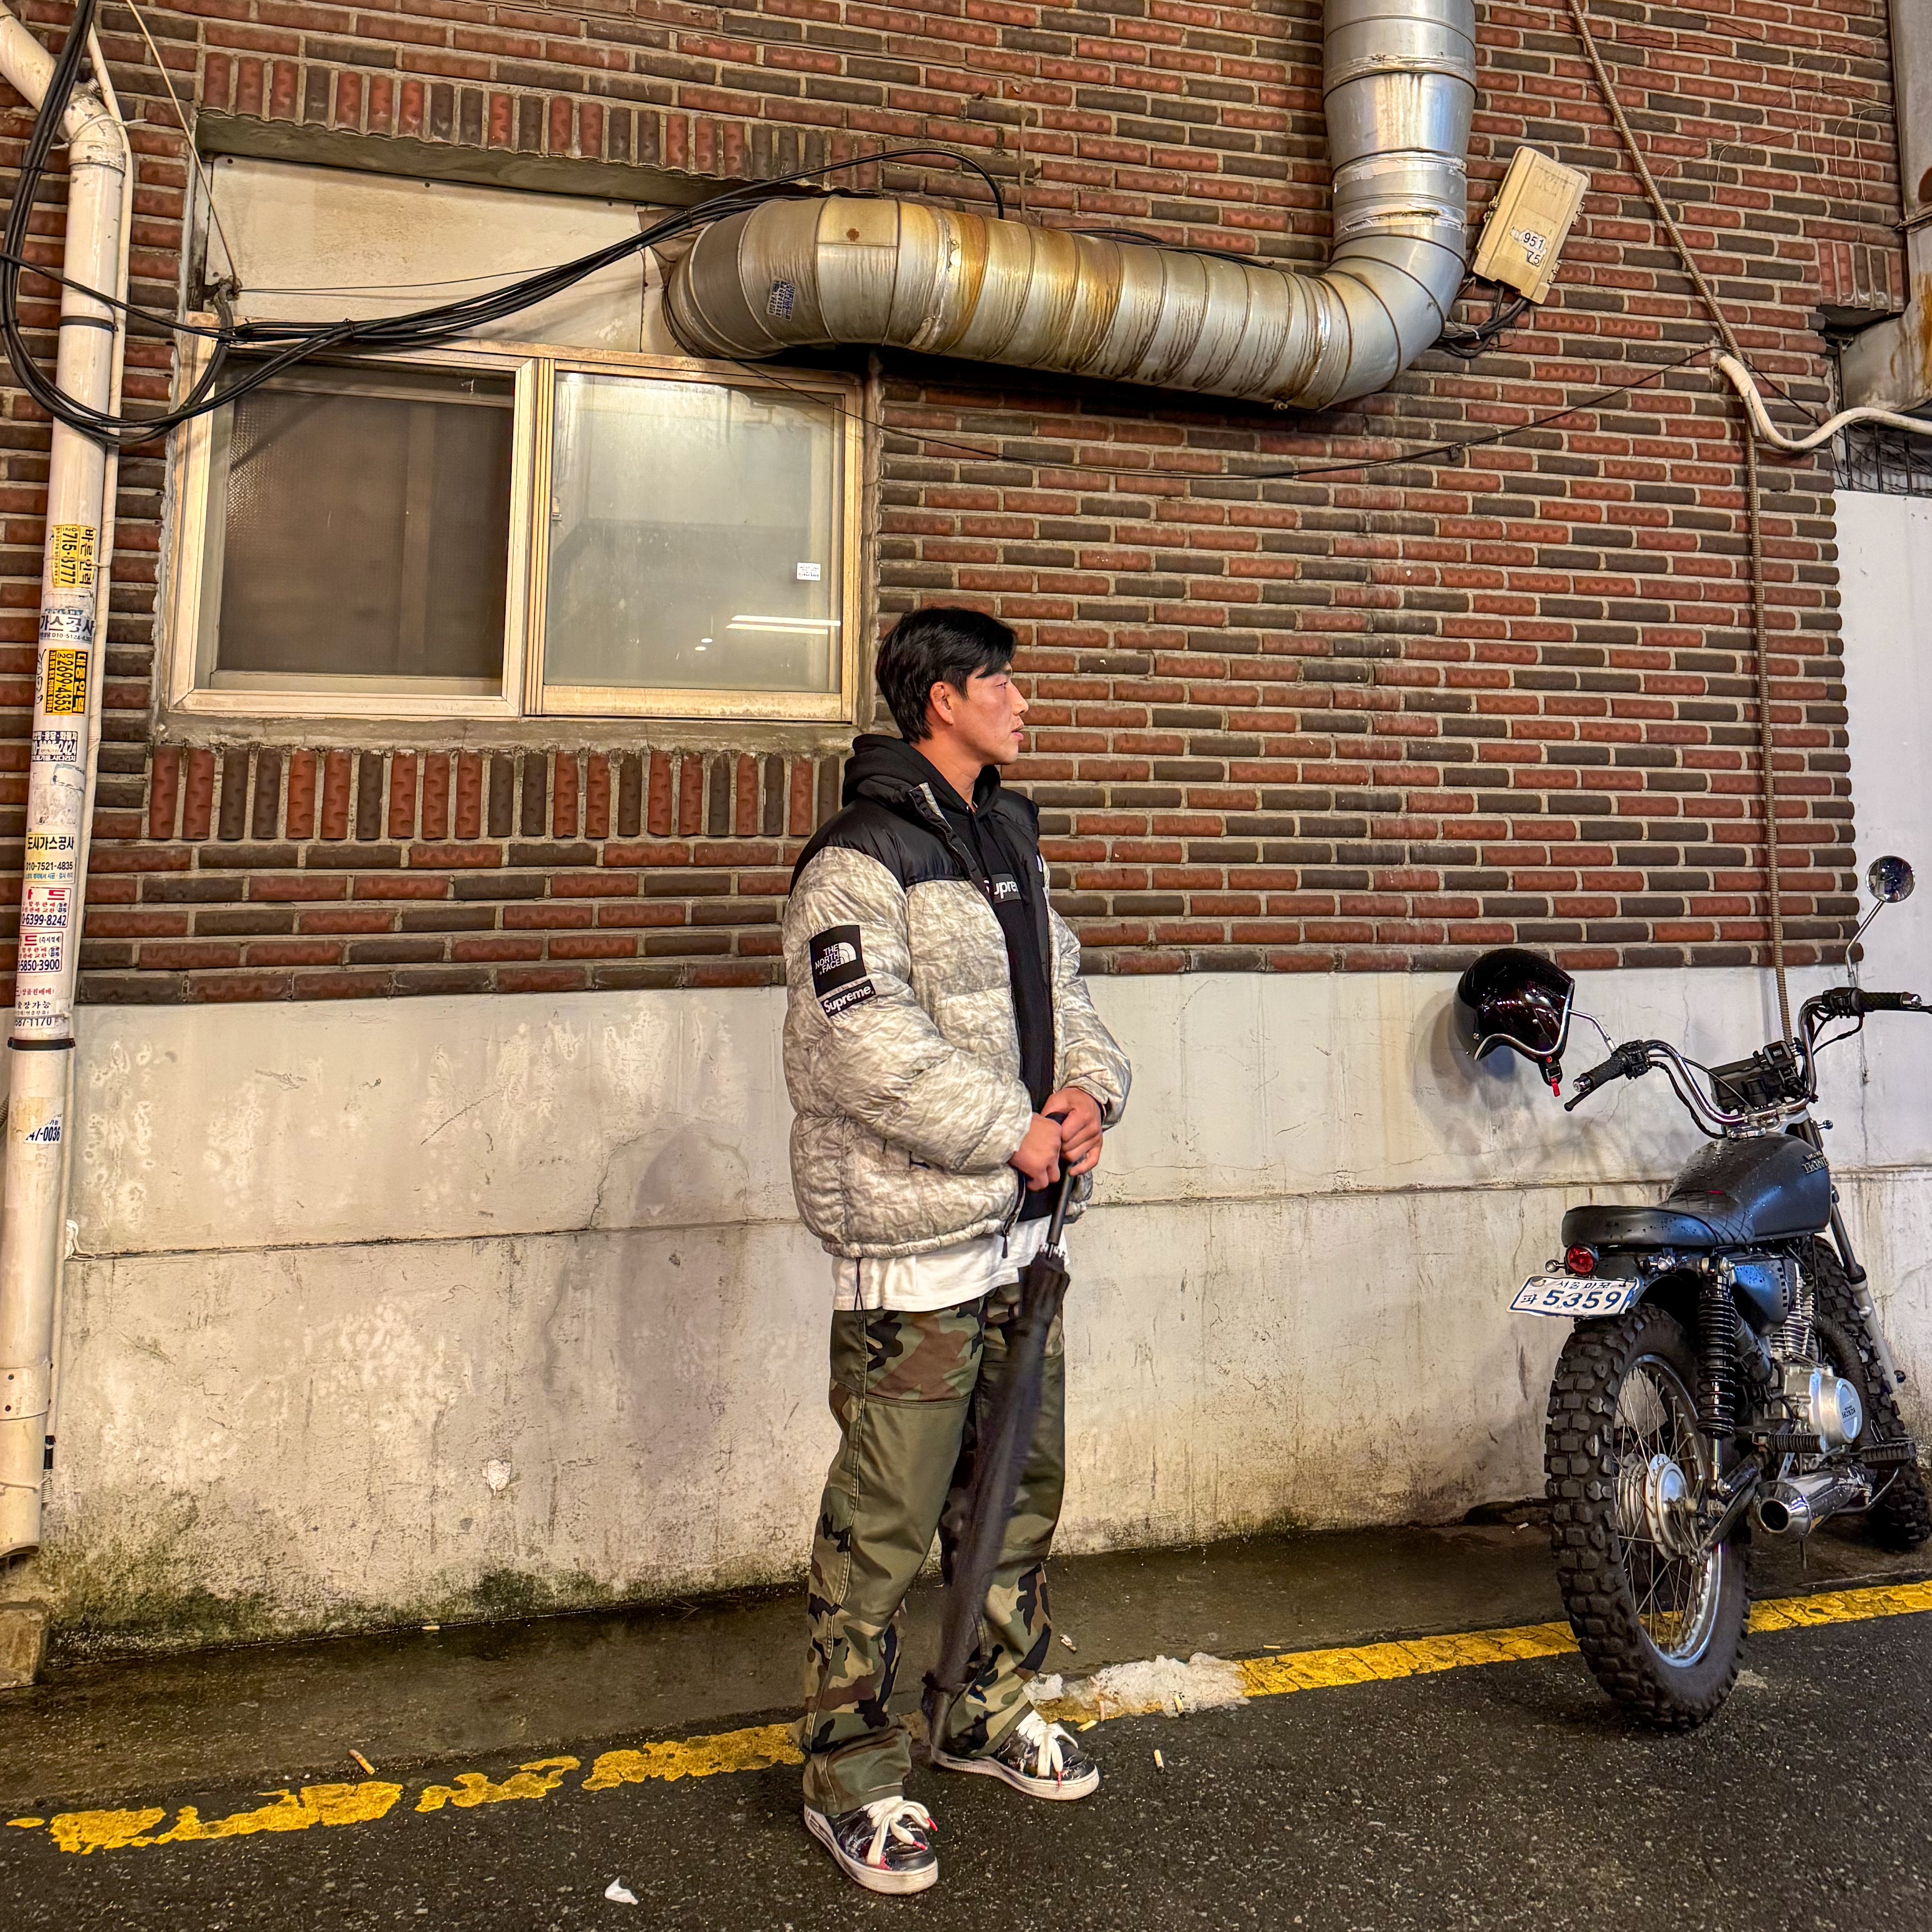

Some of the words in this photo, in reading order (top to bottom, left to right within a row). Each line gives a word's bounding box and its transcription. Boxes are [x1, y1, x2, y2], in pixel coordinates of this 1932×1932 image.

[1523, 233, 1544, 249] 951
[27, 836, 74, 850] 도시가스공사
[823, 944, 839, 956] THE
[815, 952, 839, 969] NORTH
[822, 959, 841, 973] FACE
[824, 986, 871, 1013] Supreme
[1557, 1281, 1580, 1289] 서울
[1521, 1294, 1537, 1304] 파
[1543, 1290, 1622, 1310] 5359
